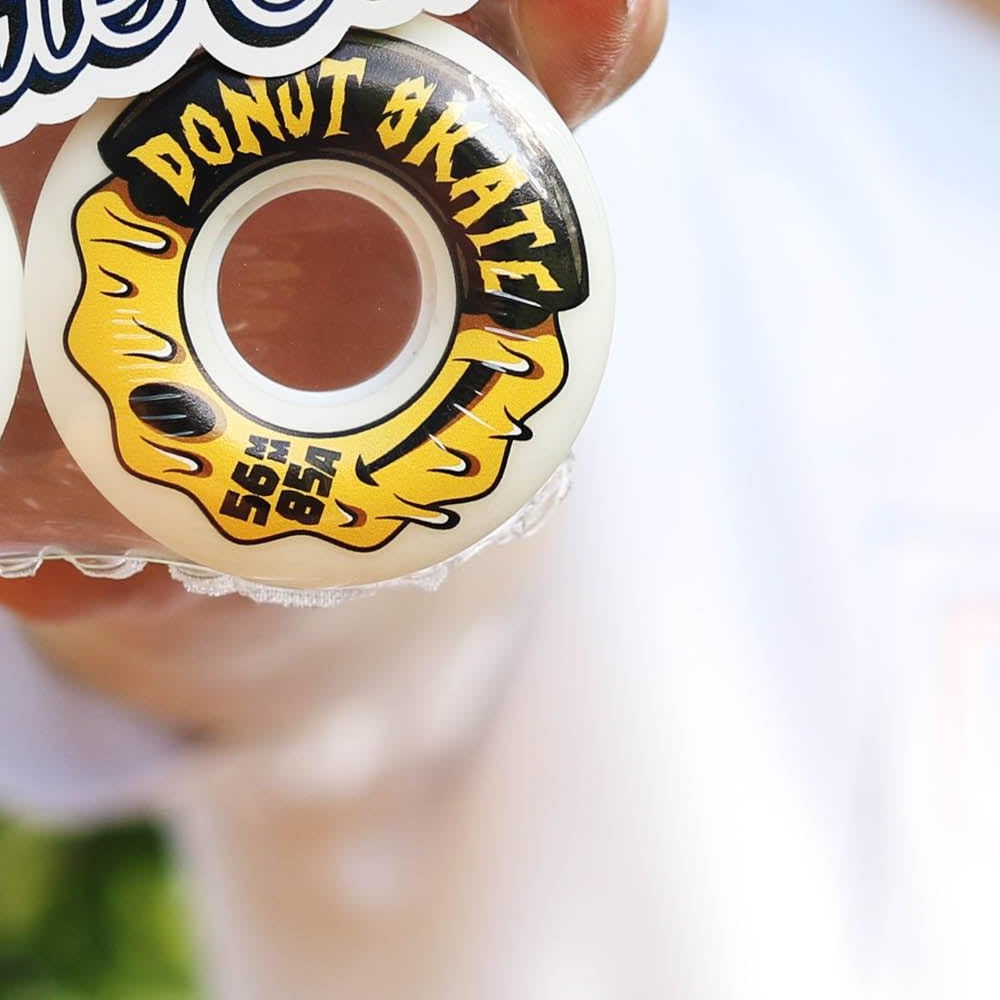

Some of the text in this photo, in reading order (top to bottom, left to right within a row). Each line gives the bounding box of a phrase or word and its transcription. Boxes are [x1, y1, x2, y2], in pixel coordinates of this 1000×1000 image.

[127, 58, 564, 293] DONUT SKATE
[276, 445, 341, 525] 85A
